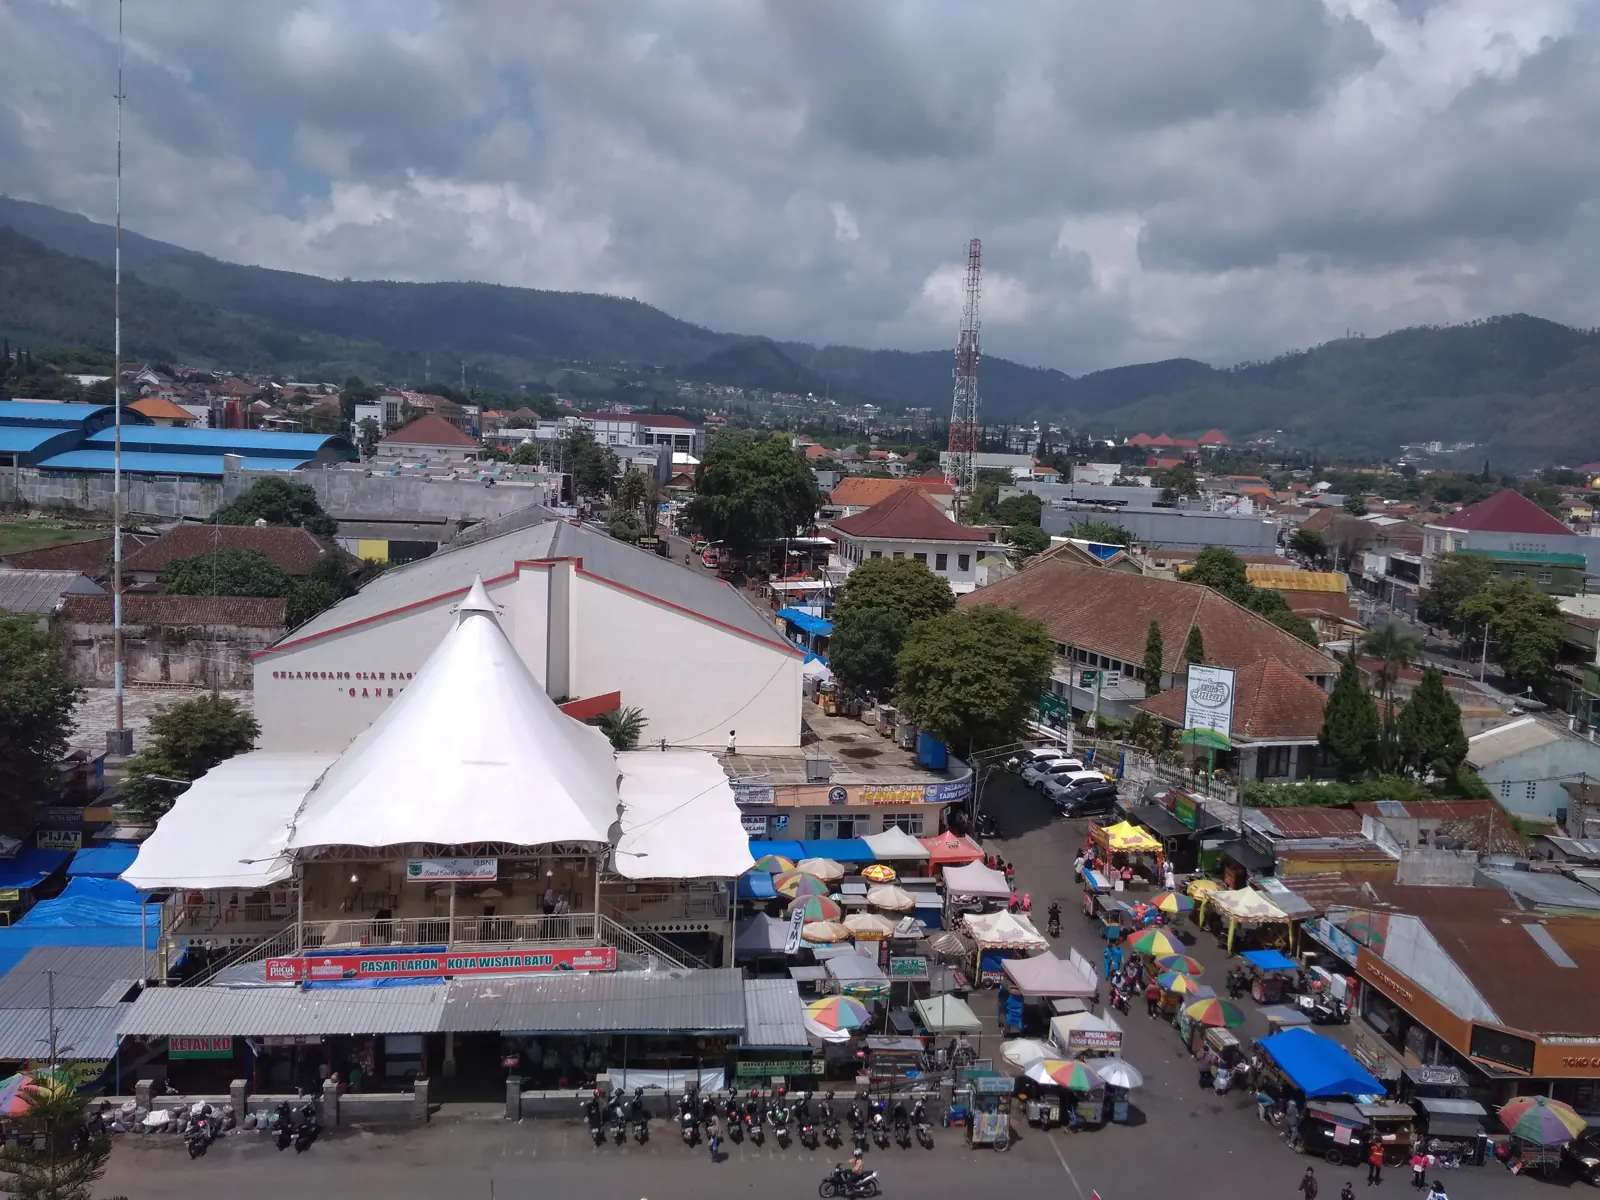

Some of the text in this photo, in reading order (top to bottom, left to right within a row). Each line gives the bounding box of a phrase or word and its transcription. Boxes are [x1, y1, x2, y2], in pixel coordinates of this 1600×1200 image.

[272, 671, 417, 681] GELANGGANG OLAH RAG
[338, 688, 404, 698] "GANE
[38, 831, 80, 842] PIJAT
[360, 960, 398, 973] PASAR
[400, 959, 438, 971] LARON
[448, 956, 476, 970] KOTA
[479, 956, 522, 968] WISATA
[524, 954, 553, 966] BATU
[270, 964, 296, 977] pucuk
[170, 1036, 232, 1050] KETAN KD
[1562, 1056, 1588, 1068] TOKO
